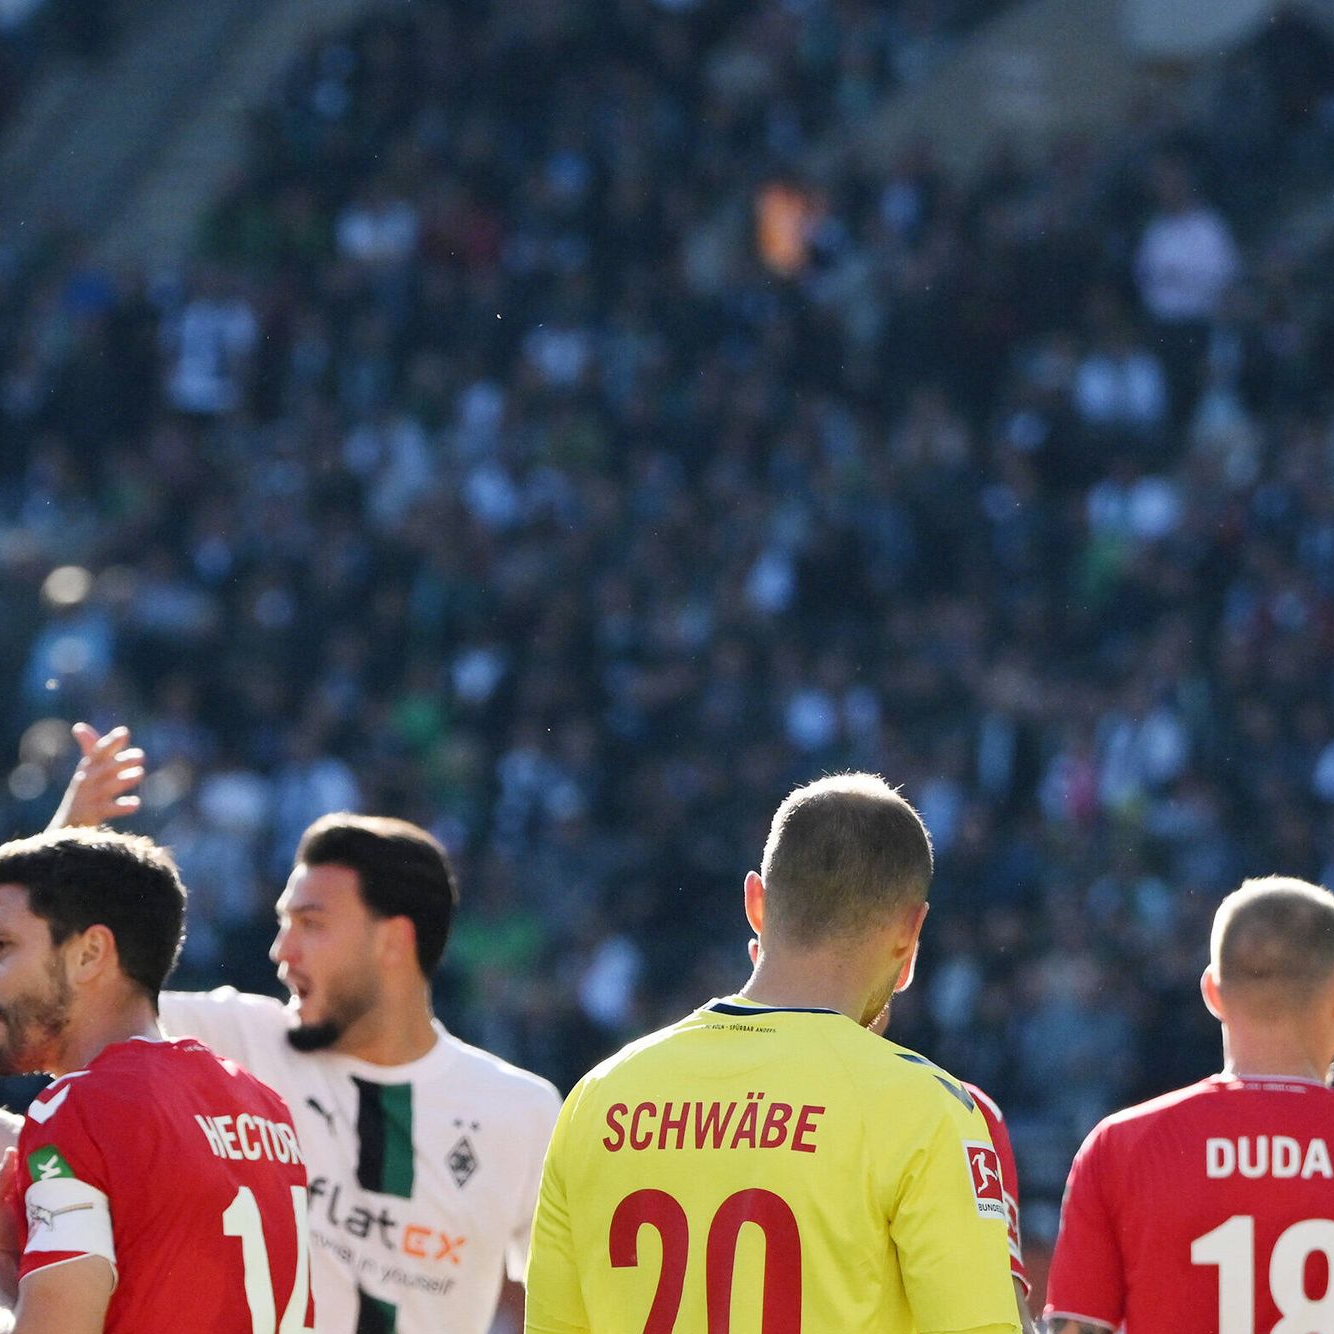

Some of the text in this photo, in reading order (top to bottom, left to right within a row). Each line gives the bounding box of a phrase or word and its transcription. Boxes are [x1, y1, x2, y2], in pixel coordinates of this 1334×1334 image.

[195, 1113, 307, 1165] HECTOR
[602, 1091, 827, 1154] SCHWÄBE
[1205, 1136, 1334, 1180] DUDA
